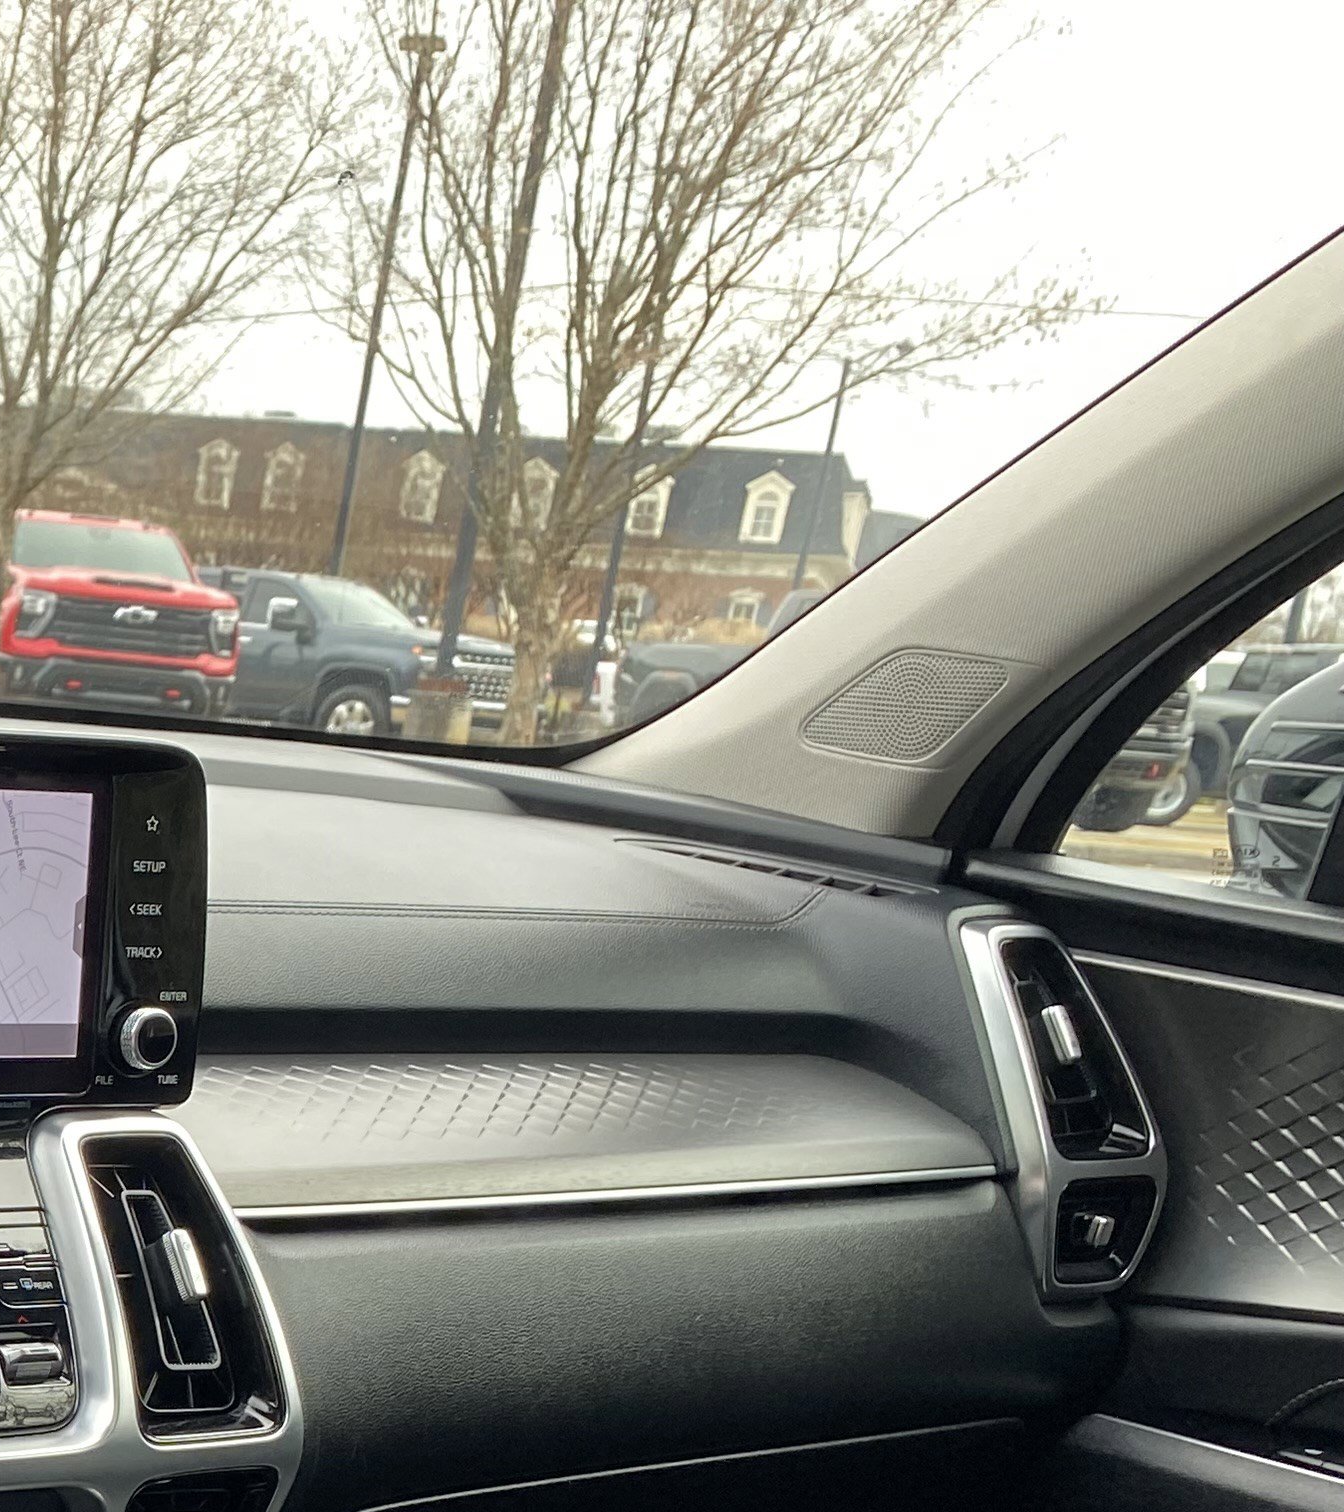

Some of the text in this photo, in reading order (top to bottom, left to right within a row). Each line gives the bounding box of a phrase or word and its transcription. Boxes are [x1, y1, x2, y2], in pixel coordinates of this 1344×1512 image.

[133, 860, 166, 873] SETUP
[159, 991, 188, 1002] ENTER
[95, 1074, 114, 1086] FILE
[157, 1074, 179, 1085] TUNE
